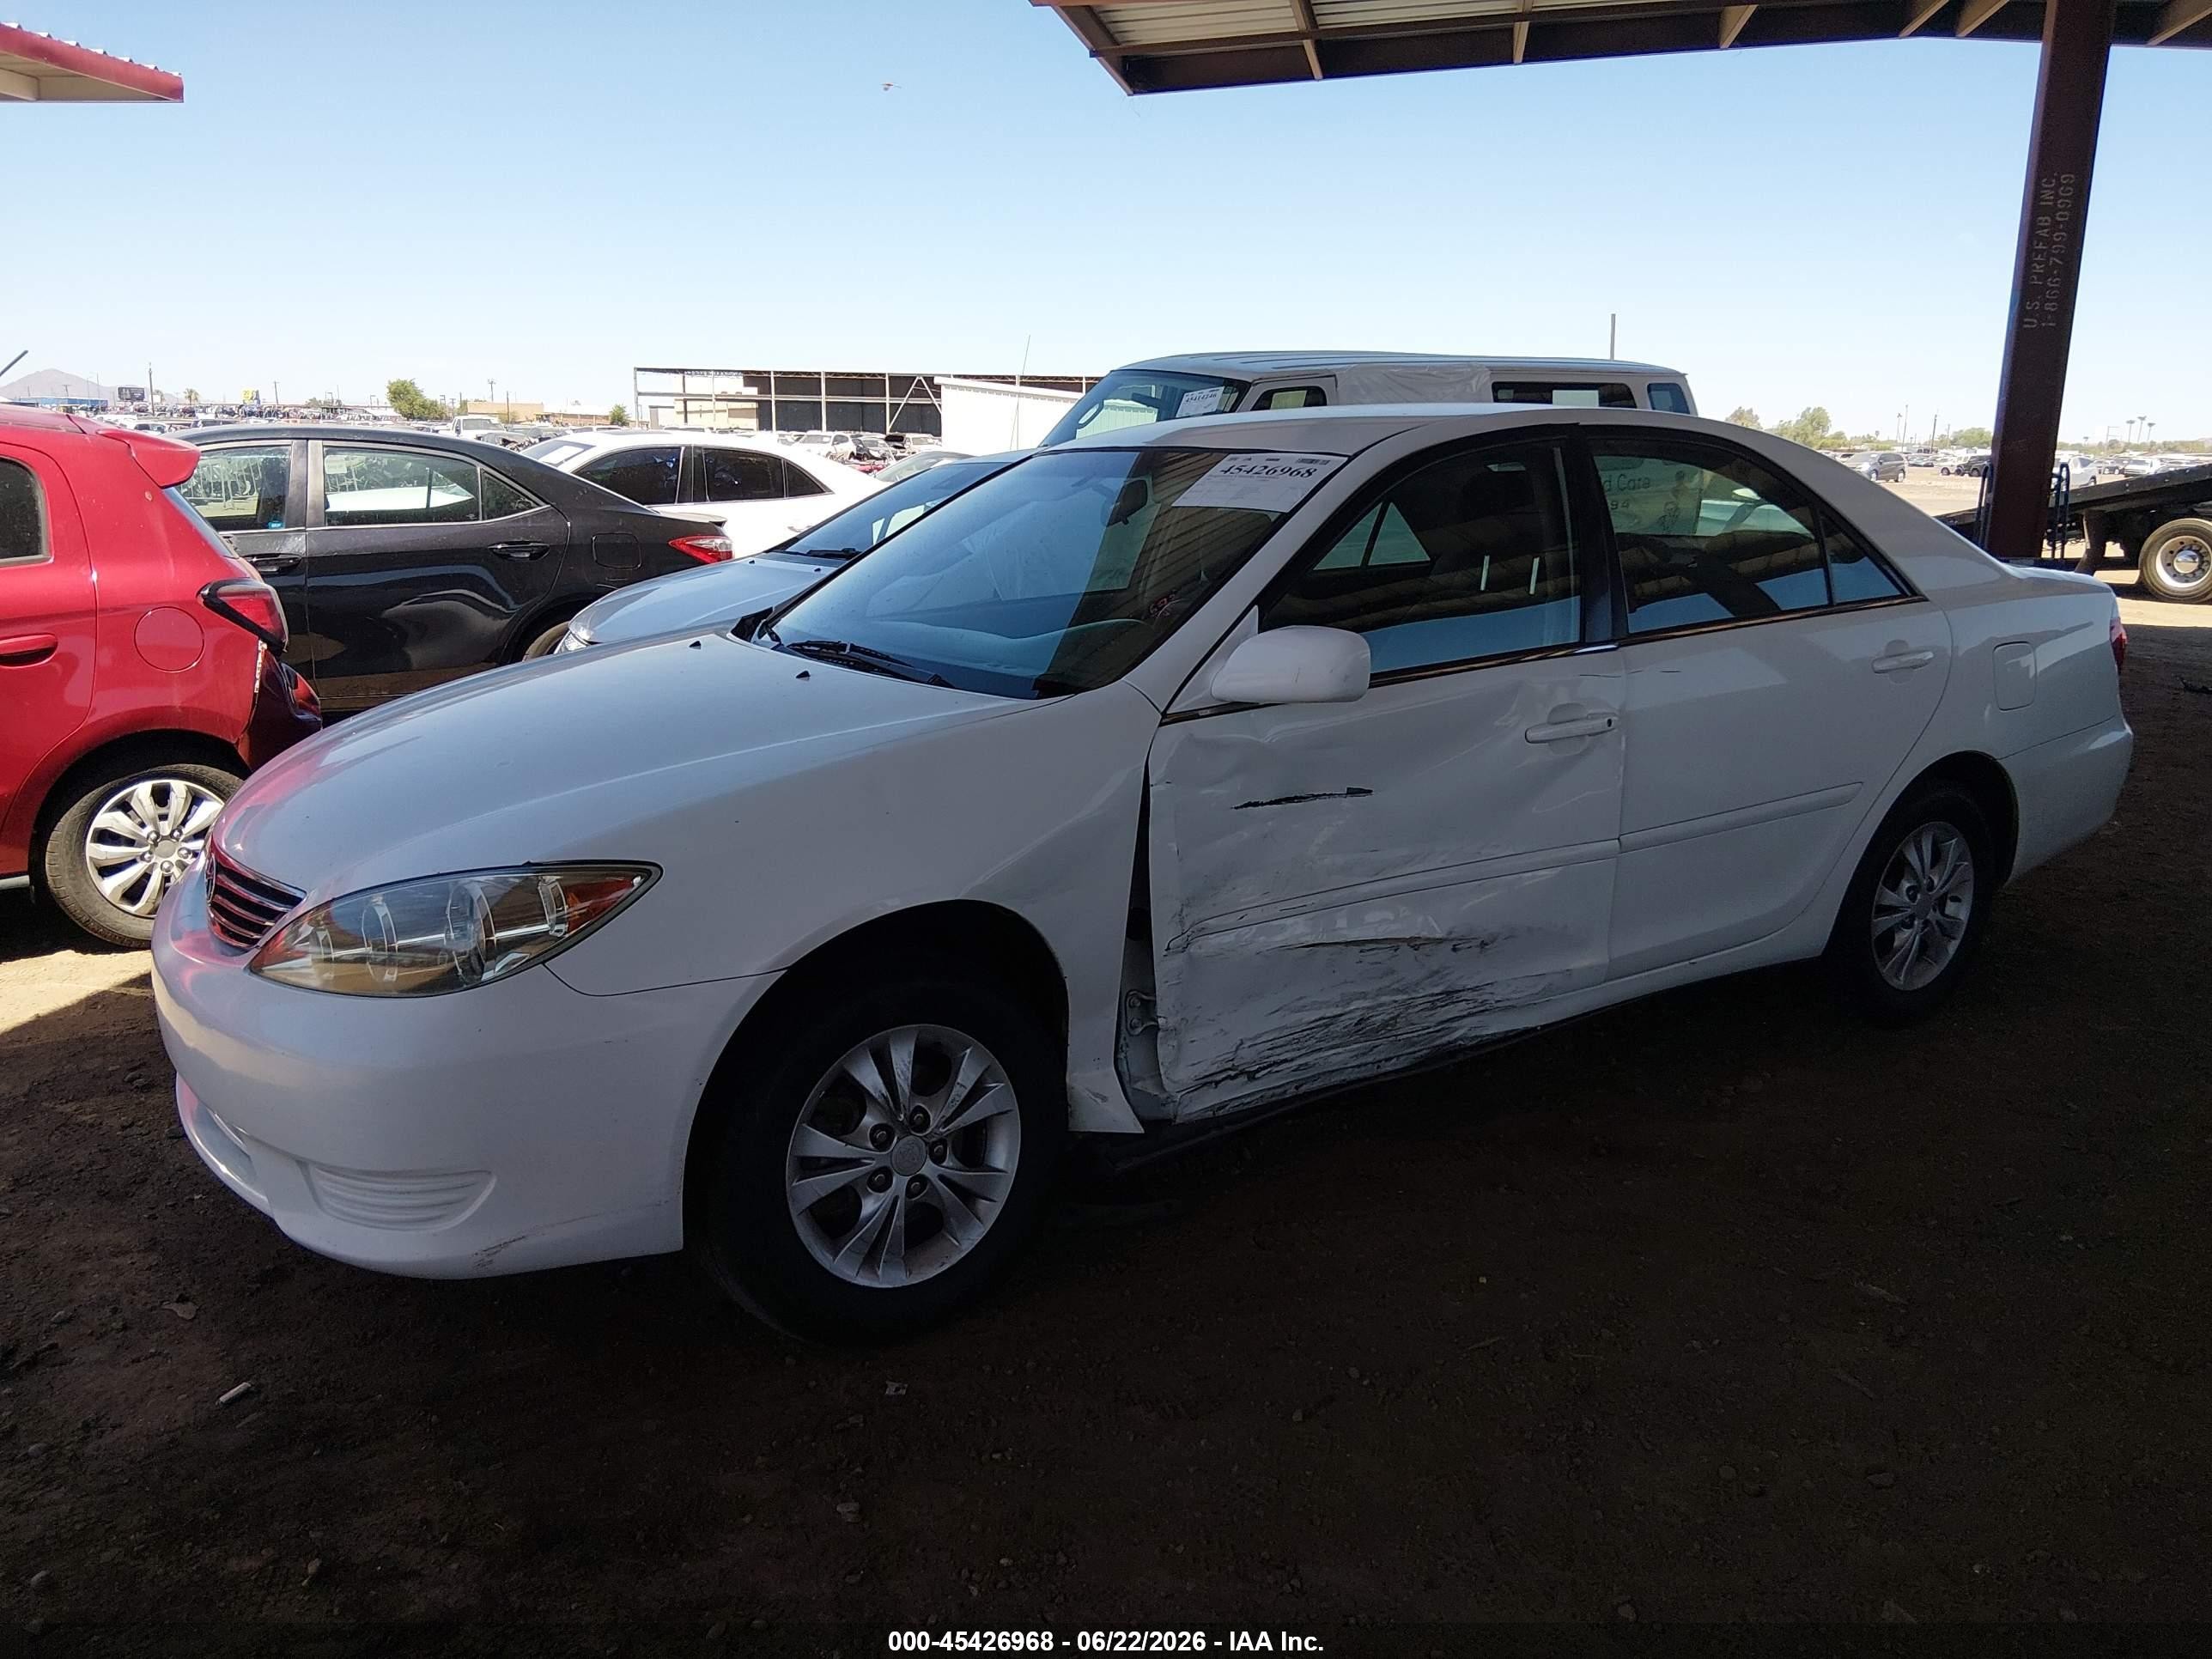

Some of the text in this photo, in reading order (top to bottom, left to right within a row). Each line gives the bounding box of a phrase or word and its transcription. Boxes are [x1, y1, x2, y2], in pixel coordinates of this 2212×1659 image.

[2023, 172, 2059, 329] U.S. PREFAB INC.
[2040, 173, 2075, 327] 1-866-799-0969
[1220, 465, 1317, 477] 45426968
